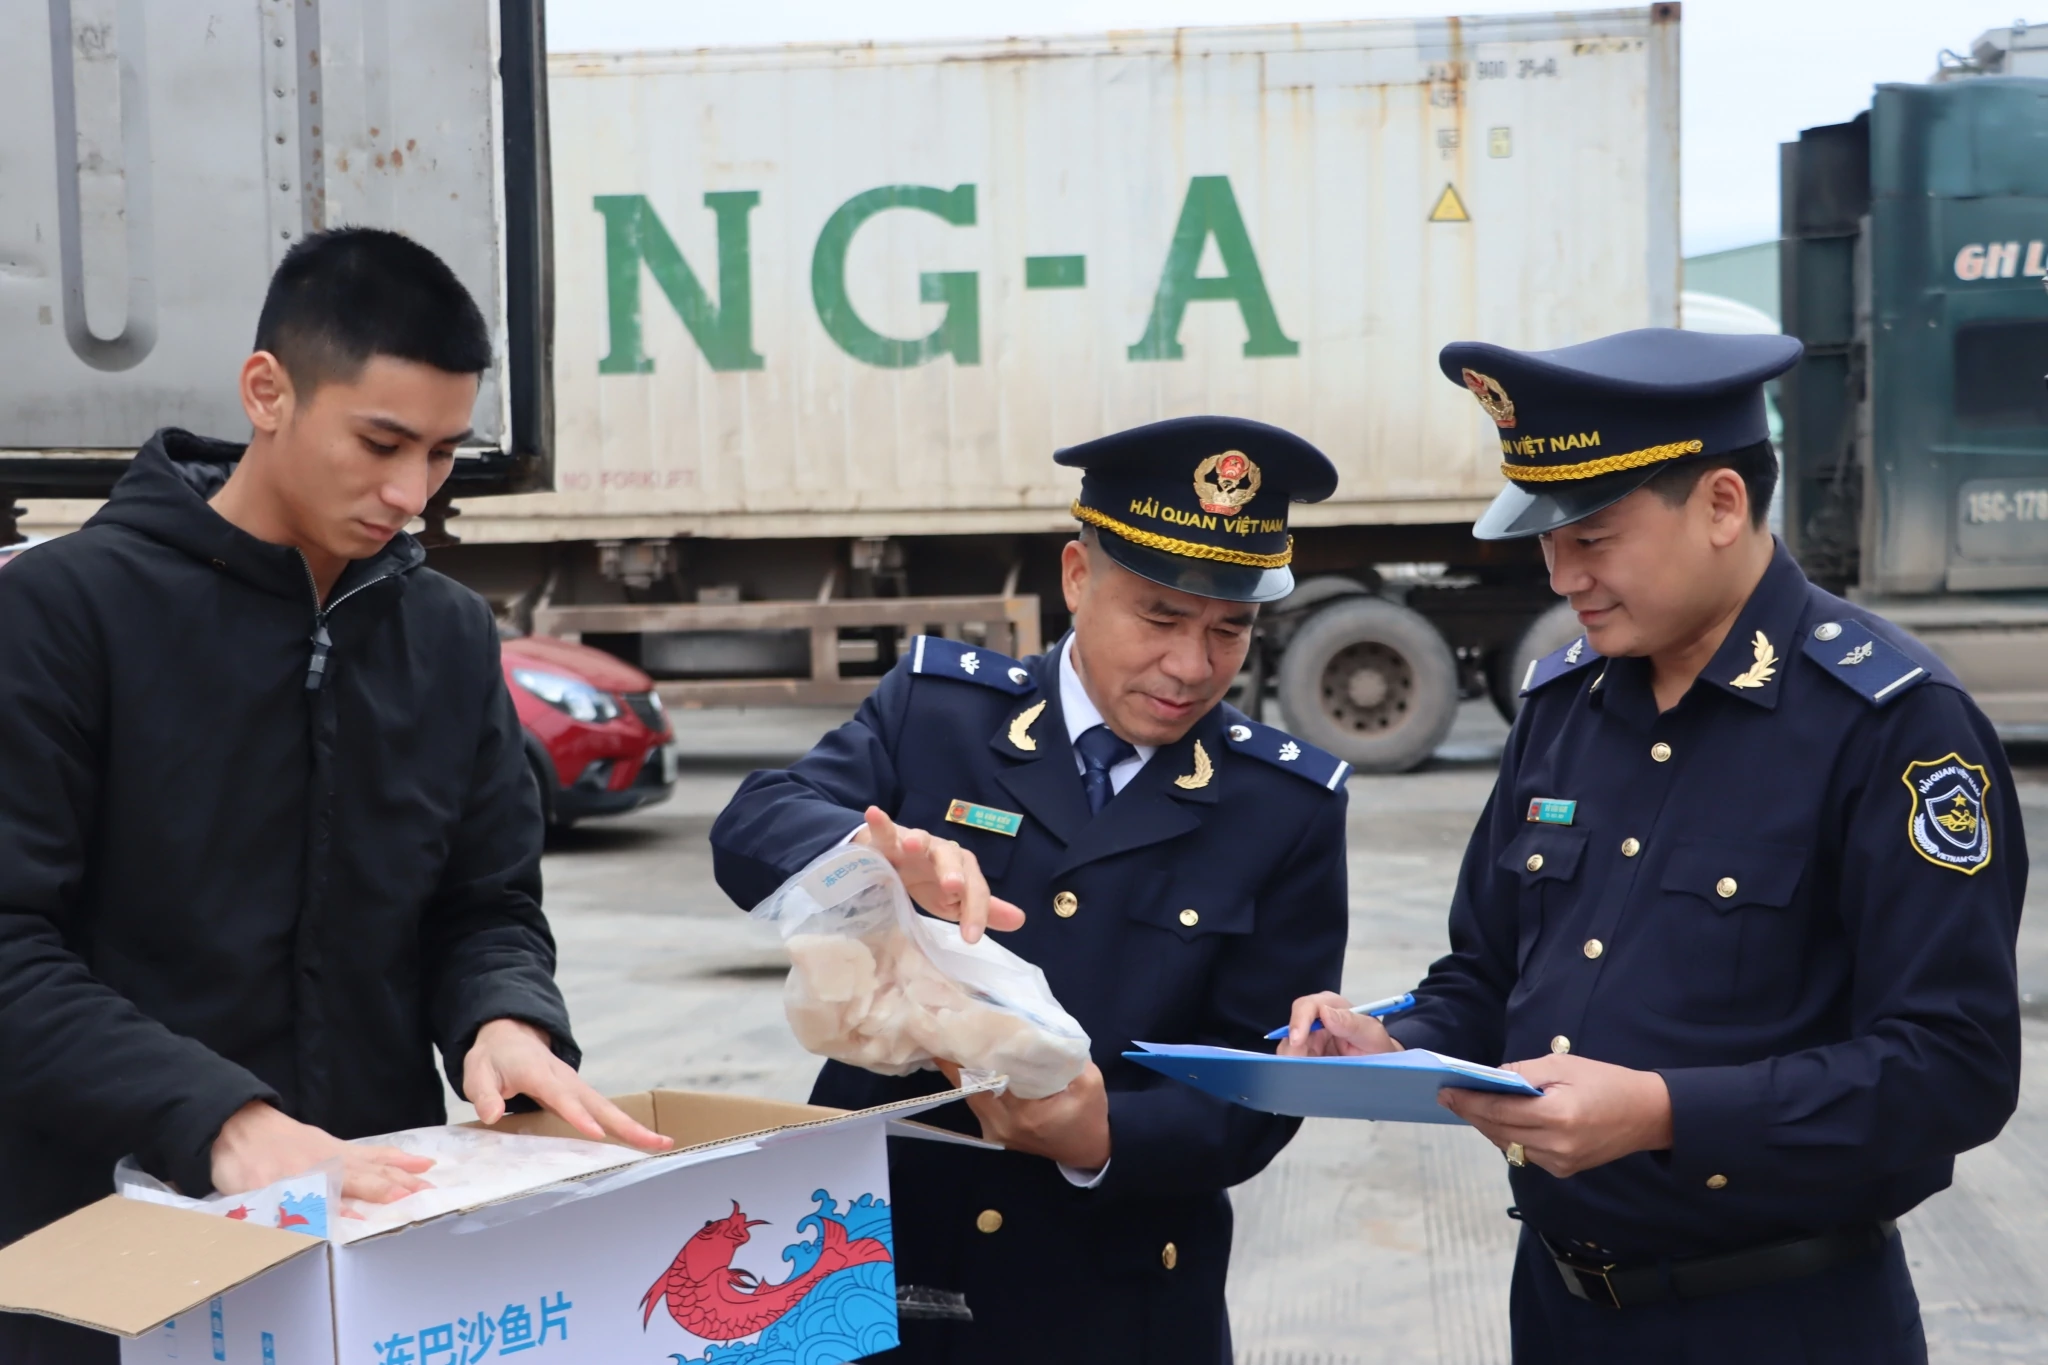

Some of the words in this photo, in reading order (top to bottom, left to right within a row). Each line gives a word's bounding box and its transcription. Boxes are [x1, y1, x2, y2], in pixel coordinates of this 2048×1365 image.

[1549, 430, 1601, 453] NAM
[1129, 497, 1160, 518] HẢI
[1161, 507, 1217, 531] QUAN
[1223, 516, 1260, 537] VIỆT
[1260, 518, 1284, 533] NAM
